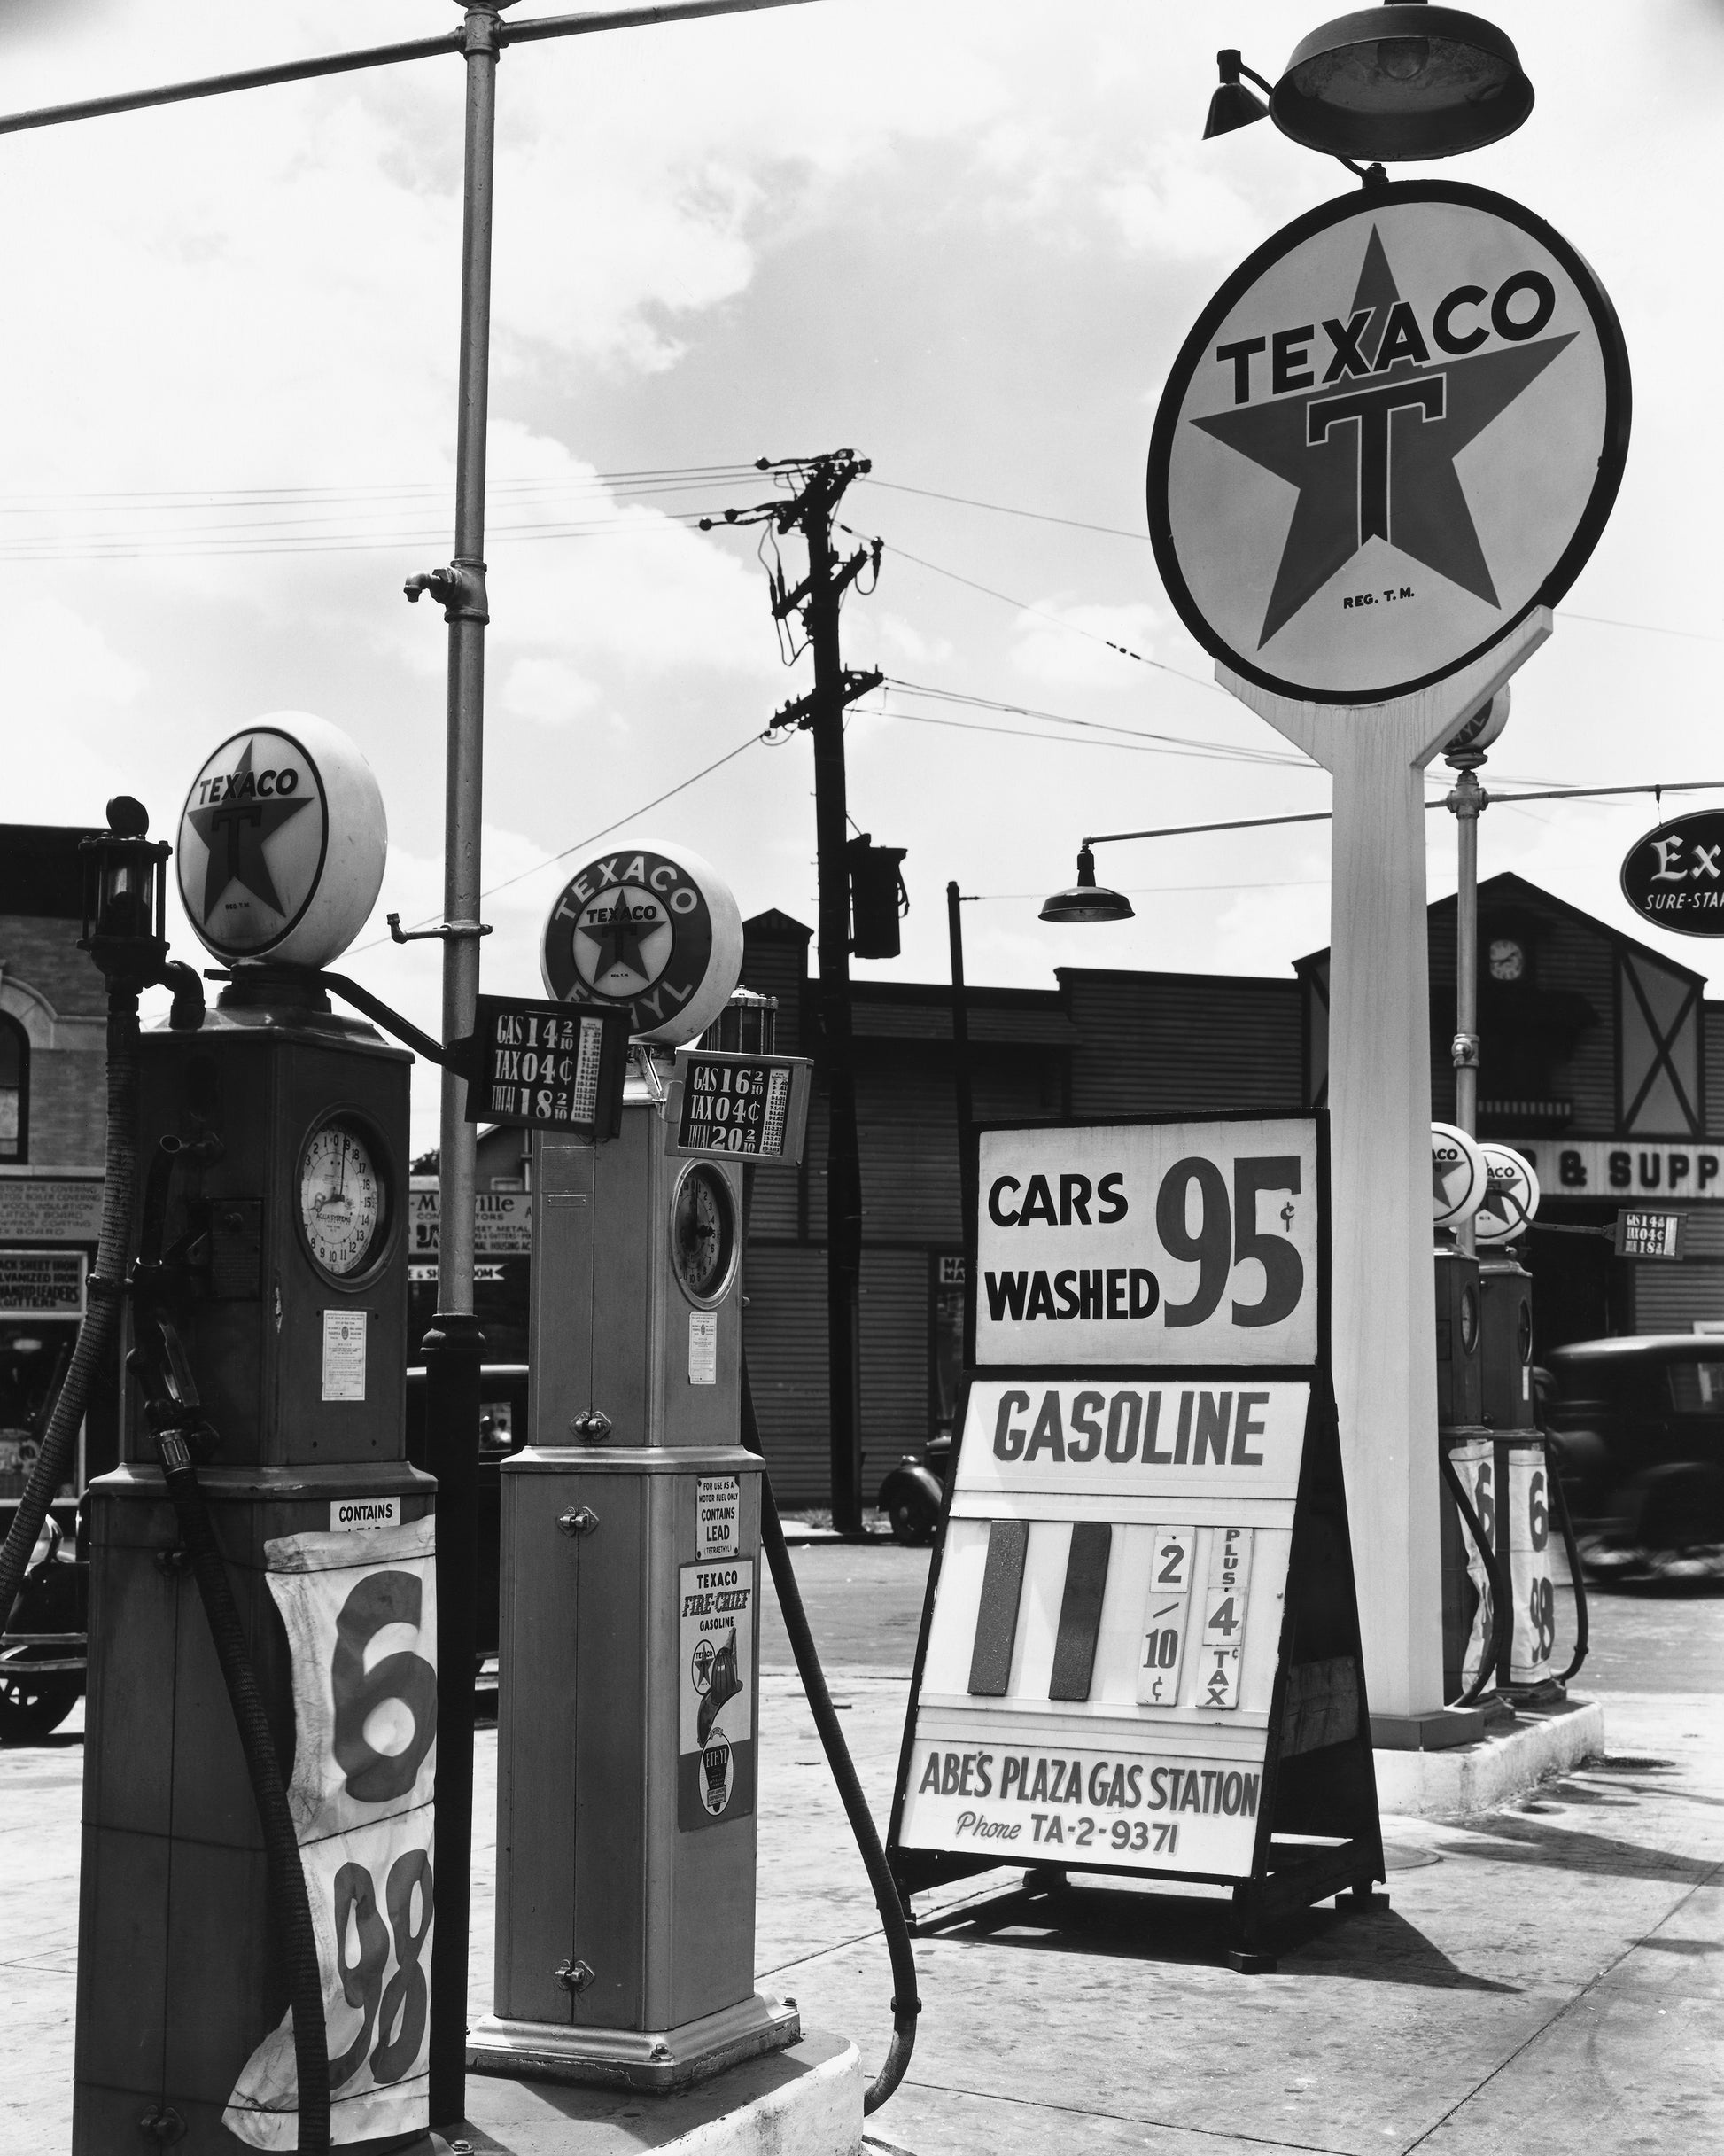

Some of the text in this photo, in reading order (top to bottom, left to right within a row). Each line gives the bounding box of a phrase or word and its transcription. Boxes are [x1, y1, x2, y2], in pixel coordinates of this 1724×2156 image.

[1216, 270, 1556, 405] TEXACO
[1307, 372, 1446, 550] T
[1343, 593, 1379, 609] REG.
[199, 768, 299, 805] TEXACO
[554, 856, 698, 921] TEXACO
[586, 905, 657, 923] TEXACO
[497, 1015, 524, 1045] GAS
[526, 1017, 559, 1049] 14
[495, 1050, 521, 1080] TAX
[693, 1066, 719, 1092] GAS
[721, 1068, 752, 1094] 16
[520, 1088, 553, 1119] 18
[690, 1095, 714, 1121] TAX
[711, 1126, 743, 1152] 20
[352, 1149, 360, 1160] 18
[359, 1163, 366, 1173] 17
[1560, 1150, 1587, 1187] &
[1609, 1151, 1719, 1190] SUPP
[363, 1179, 370, 1190] 16
[364, 1197, 371, 1208] 15
[988, 1172, 1129, 1227] CARS
[331, 1214, 351, 1223] SYSTEMS
[361, 1215, 369, 1225] 14
[349, 1242, 357, 1253] 12
[357, 1230, 364, 1241] 13
[320, 1247, 325, 1258] 9
[329, 1251, 337, 1262] 10
[340, 1250, 347, 1260] 11
[984, 1268, 1160, 1321] WASHED
[992, 1390, 1270, 1466] GASOLINE
[699, 1493, 738, 1503] MOTOR FUEL ONLY
[338, 1503, 393, 1522] CONTAINS
[701, 1507, 735, 1521] CONTAINS
[1529, 1471, 1549, 1552] 6
[707, 1524, 730, 1542] LEAD
[1223, 1529, 1240, 1585] PLUS
[697, 1570, 737, 1589] TEXACO
[682, 1589, 751, 1617] FIRE-CHIEF
[700, 1616, 734, 1631] GASOLINE
[332, 1570, 438, 1803] 6
[1205, 1651, 1230, 1705] TAX
[706, 1748, 727, 1768] ETHYL
[918, 1750, 1260, 1816] ABE'S PLAZA GAS STATION
[956, 1810, 1179, 1853] Phone TA-2-9371
[328, 1848, 435, 2091] 98
